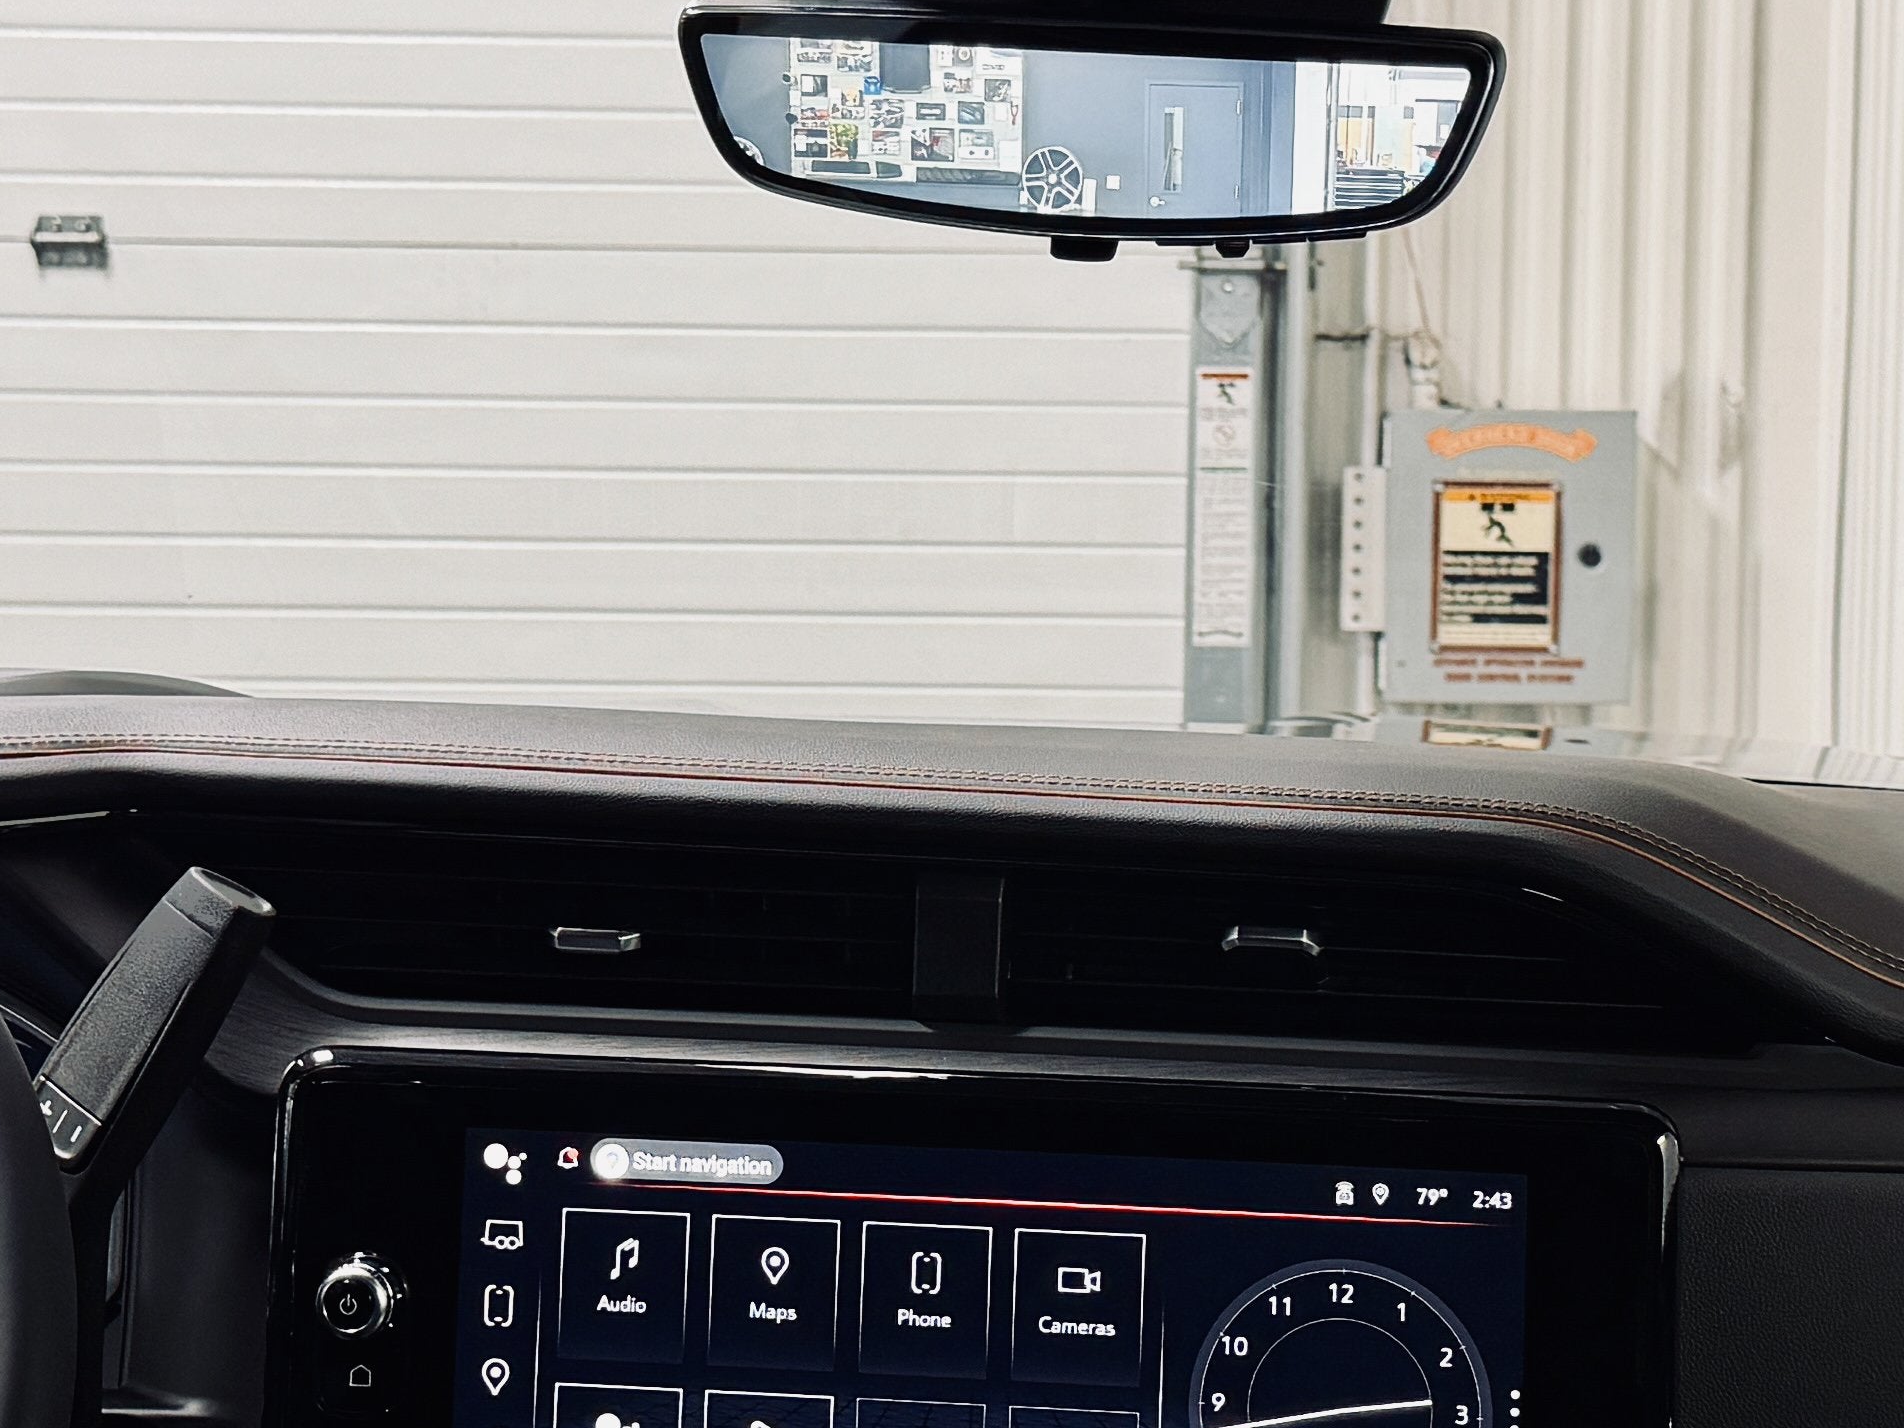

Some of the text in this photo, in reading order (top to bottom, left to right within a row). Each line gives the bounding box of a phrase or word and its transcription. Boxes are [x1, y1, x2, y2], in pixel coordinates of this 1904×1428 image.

[632, 1151, 773, 1178] Start navigation
[1471, 1190, 1513, 1210] 2:43
[596, 1294, 647, 1314] Audio
[1328, 1283, 1355, 1304] 12
[748, 1300, 798, 1324] Maps
[1268, 1295, 1293, 1316] 11
[1397, 1302, 1407, 1322] 1
[897, 1309, 952, 1329] Phone
[1038, 1315, 1116, 1337] Cameras
[1220, 1335, 1249, 1356] 10
[1439, 1347, 1454, 1368] 2
[1211, 1392, 1227, 1413] 9
[1454, 1405, 1470, 1426] 3
